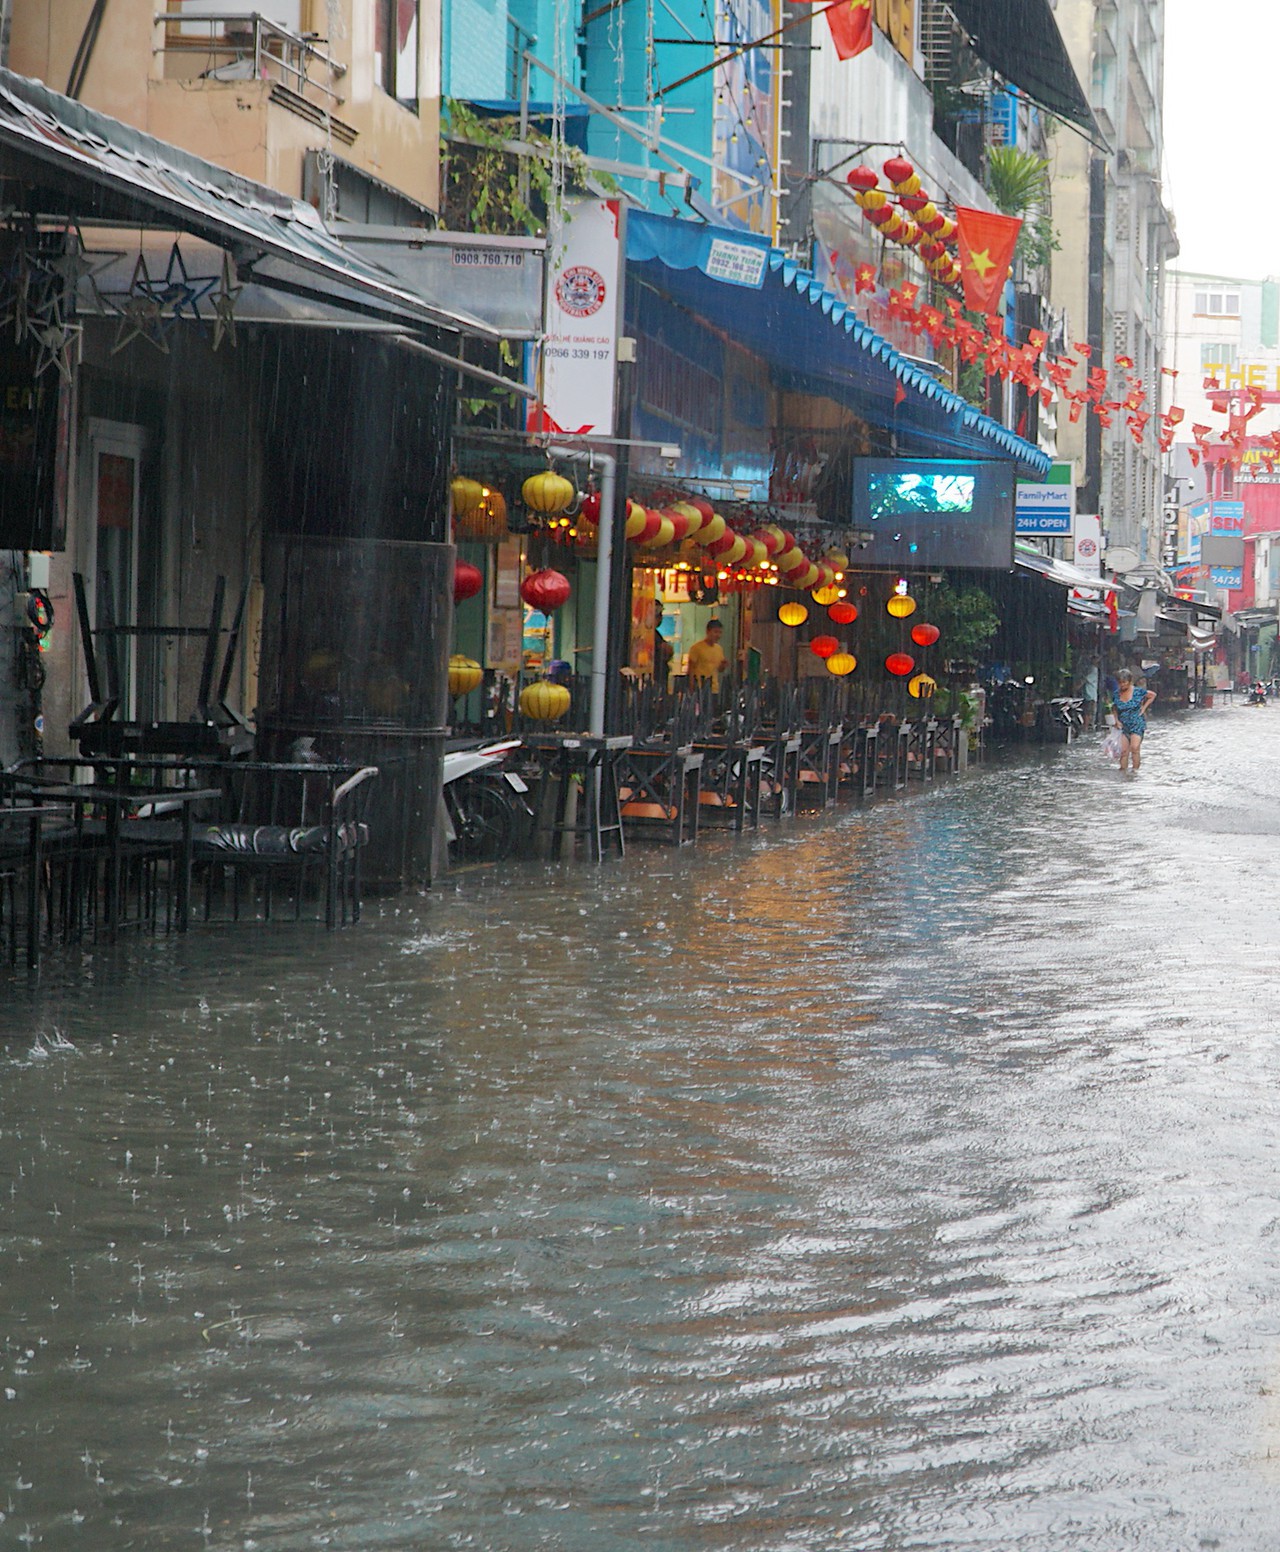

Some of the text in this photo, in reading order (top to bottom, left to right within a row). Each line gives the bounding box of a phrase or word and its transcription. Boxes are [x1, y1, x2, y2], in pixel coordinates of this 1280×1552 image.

[454, 253, 522, 266] 0908.760.710
[572, 348, 590, 359] 339
[593, 350, 610, 360] 197
[1203, 363, 1268, 391] THE
[1017, 490, 1068, 502] FamilyMart
[1017, 518, 1067, 528] 24H OPEN
[1213, 575, 1241, 585] 24/24
